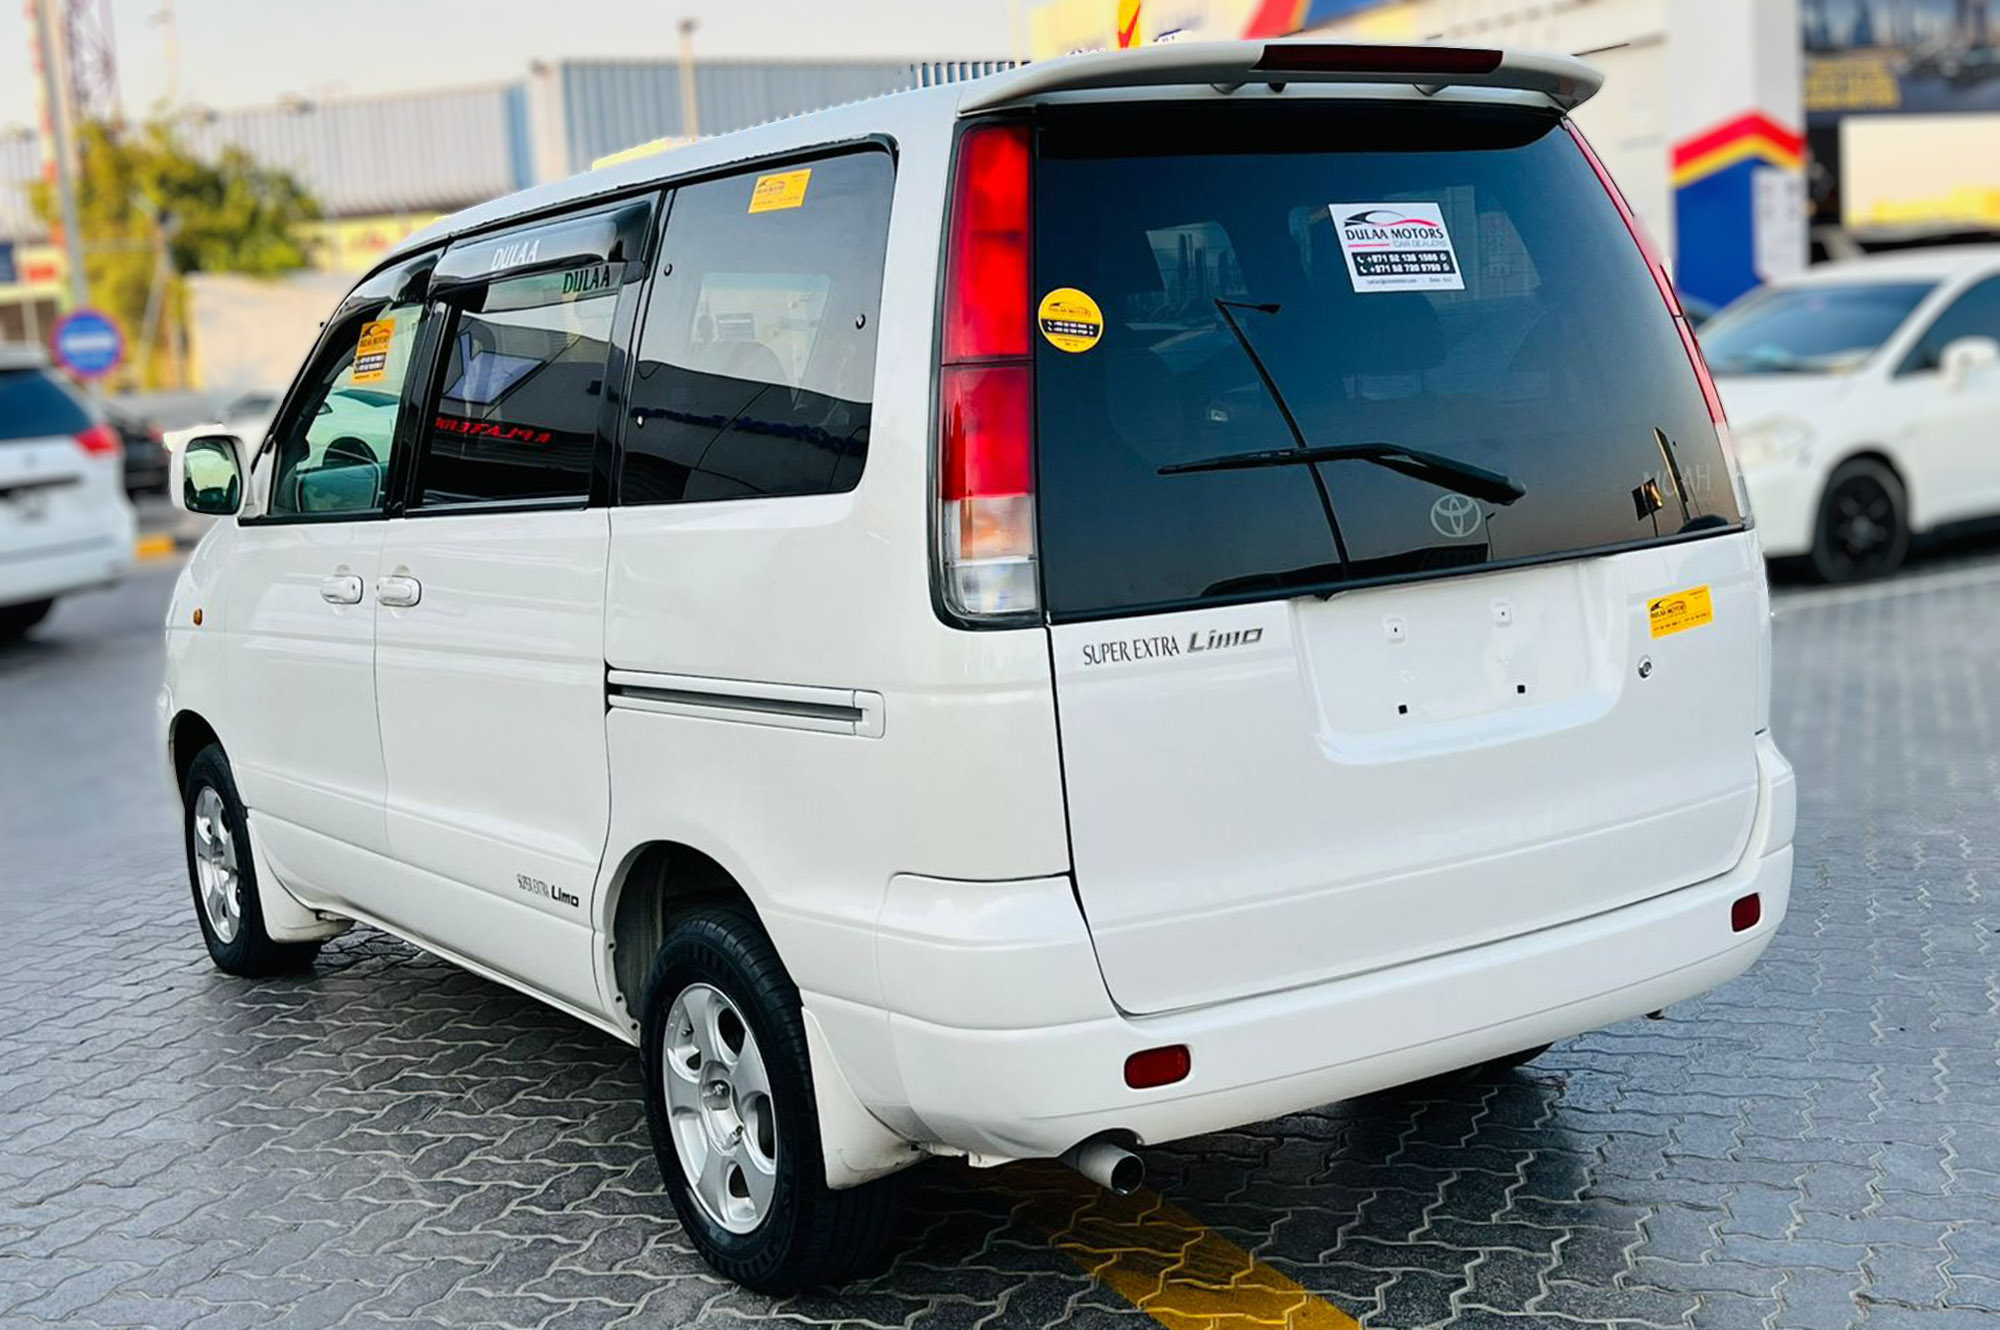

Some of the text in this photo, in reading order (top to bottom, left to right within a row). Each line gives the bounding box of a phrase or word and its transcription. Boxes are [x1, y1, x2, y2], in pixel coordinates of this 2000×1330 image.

[1345, 228, 1443, 240] DULAA MOTORS
[1412, 239, 1446, 247] DEALERS
[490, 240, 539, 271] DULAA
[562, 265, 610, 294] DULAA
[1082, 627, 1264, 666] SUPER EXTRA Limo
[551, 885, 579, 907] Limo
